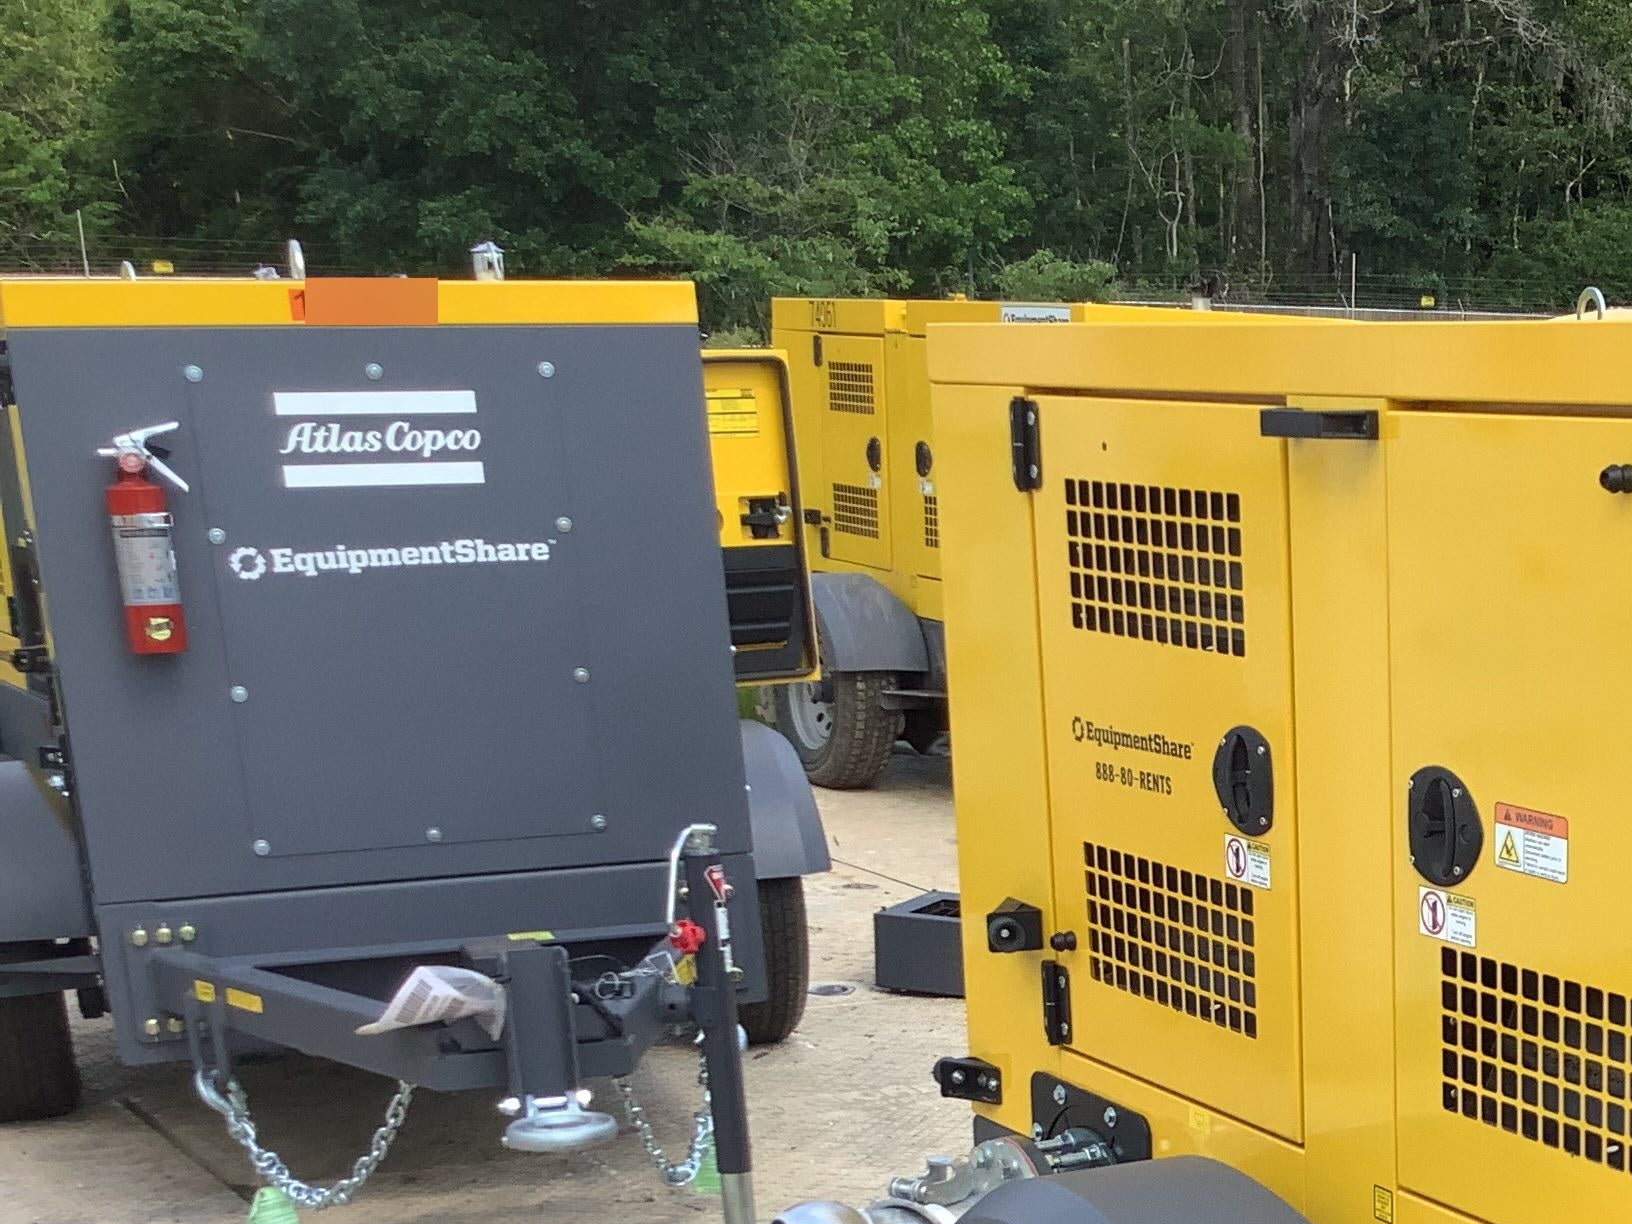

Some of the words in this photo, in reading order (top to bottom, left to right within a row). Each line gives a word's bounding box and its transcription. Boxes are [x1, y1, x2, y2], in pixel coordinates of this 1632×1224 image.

[279, 421, 382, 454] Atlas
[385, 420, 481, 457] Copco
[269, 538, 549, 577] EquipmentShare
[1085, 720, 1192, 760] EquipmentShare
[1095, 761, 1173, 796] 888-80-RENTS
[1515, 812, 1554, 831] WARNING
